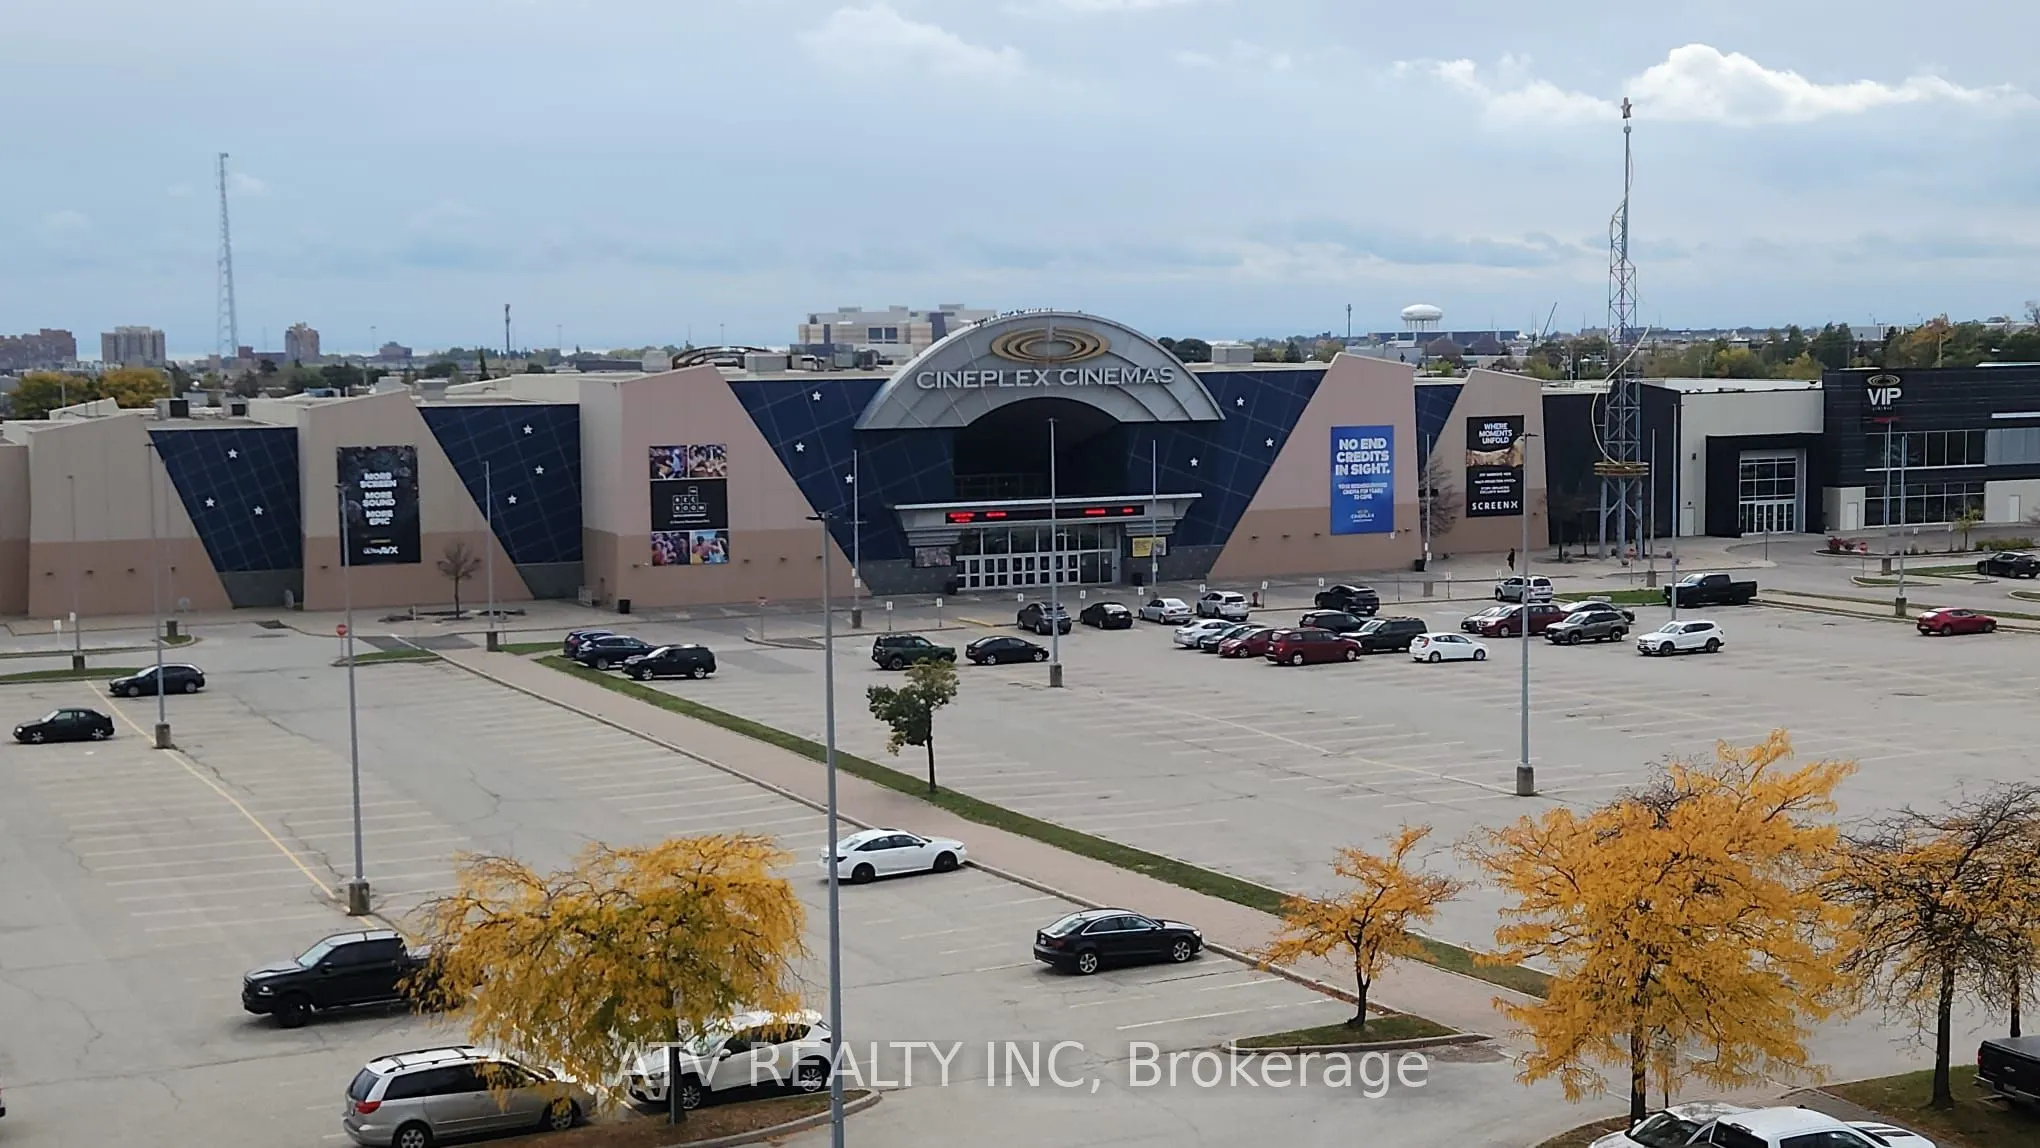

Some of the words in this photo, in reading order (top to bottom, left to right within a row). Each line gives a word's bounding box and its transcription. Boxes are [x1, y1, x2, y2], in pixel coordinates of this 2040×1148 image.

[916, 370, 1050, 389] CINEPLEX
[1059, 366, 1177, 385] CINEMAS
[1867, 387, 1902, 406] VIP
[1484, 422, 1509, 430] WHERE
[1479, 429, 1512, 438] MOMENTS
[1339, 438, 1359, 450] NO
[1360, 437, 1387, 450] END
[1482, 437, 1510, 445] UNFOLD
[1336, 450, 1390, 463] CREDITS
[1335, 463, 1349, 476] IN
[1350, 462, 1391, 475] SIGHT.
[364, 472, 392, 480] MORE
[360, 480, 397, 488] SCREEN
[365, 491, 392, 499] MORE
[362, 499, 396, 507] SOUND
[1471, 500, 1519, 511] SCREENX
[366, 510, 393, 518] MORE
